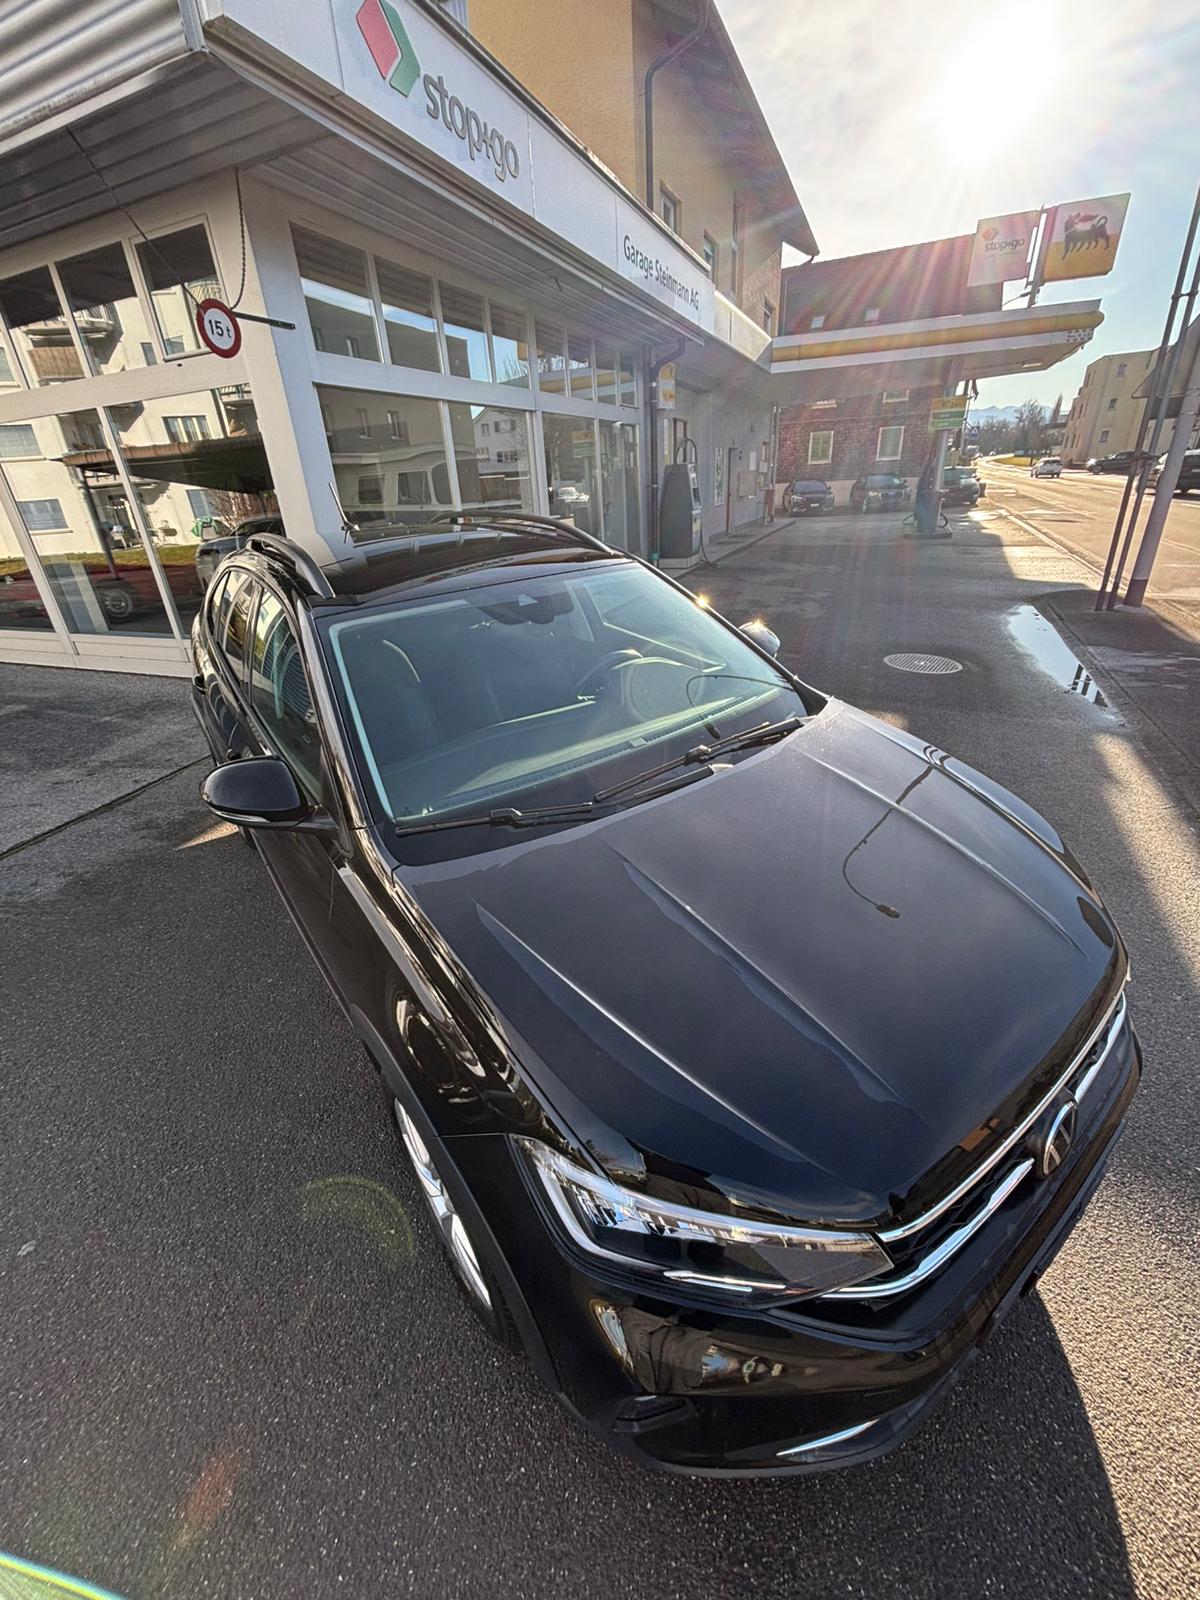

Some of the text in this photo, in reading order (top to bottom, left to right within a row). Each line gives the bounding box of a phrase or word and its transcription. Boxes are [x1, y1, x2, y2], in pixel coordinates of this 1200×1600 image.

[423, 74, 519, 182] stop+go
[624, 235, 699, 310] Garage Steinmann AG
[208, 319, 232, 339] 15 t
